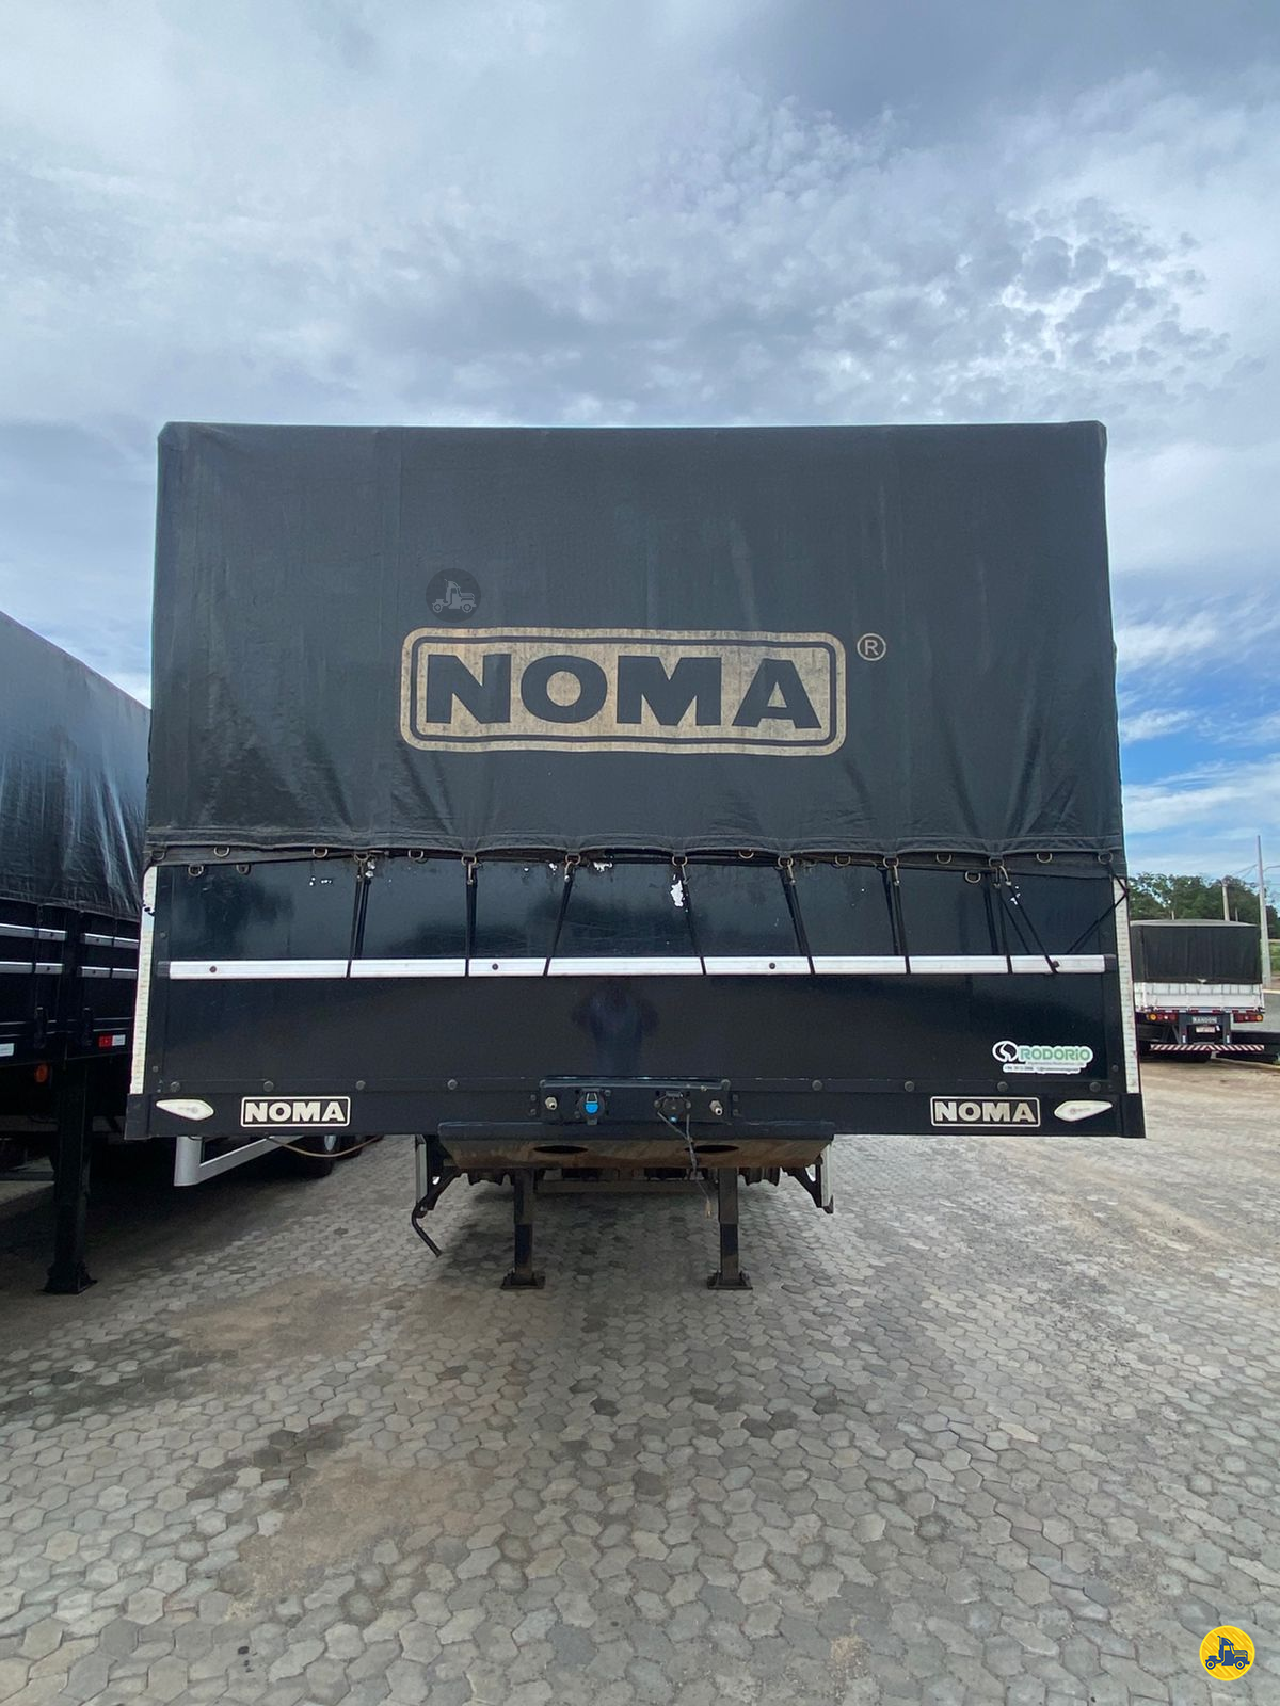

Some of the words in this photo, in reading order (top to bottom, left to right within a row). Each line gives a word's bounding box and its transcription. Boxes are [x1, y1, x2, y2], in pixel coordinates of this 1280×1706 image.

[426, 653, 822, 729] NOMA
[244, 1102, 346, 1122] NOMA
[934, 1101, 1037, 1123] NOMA
